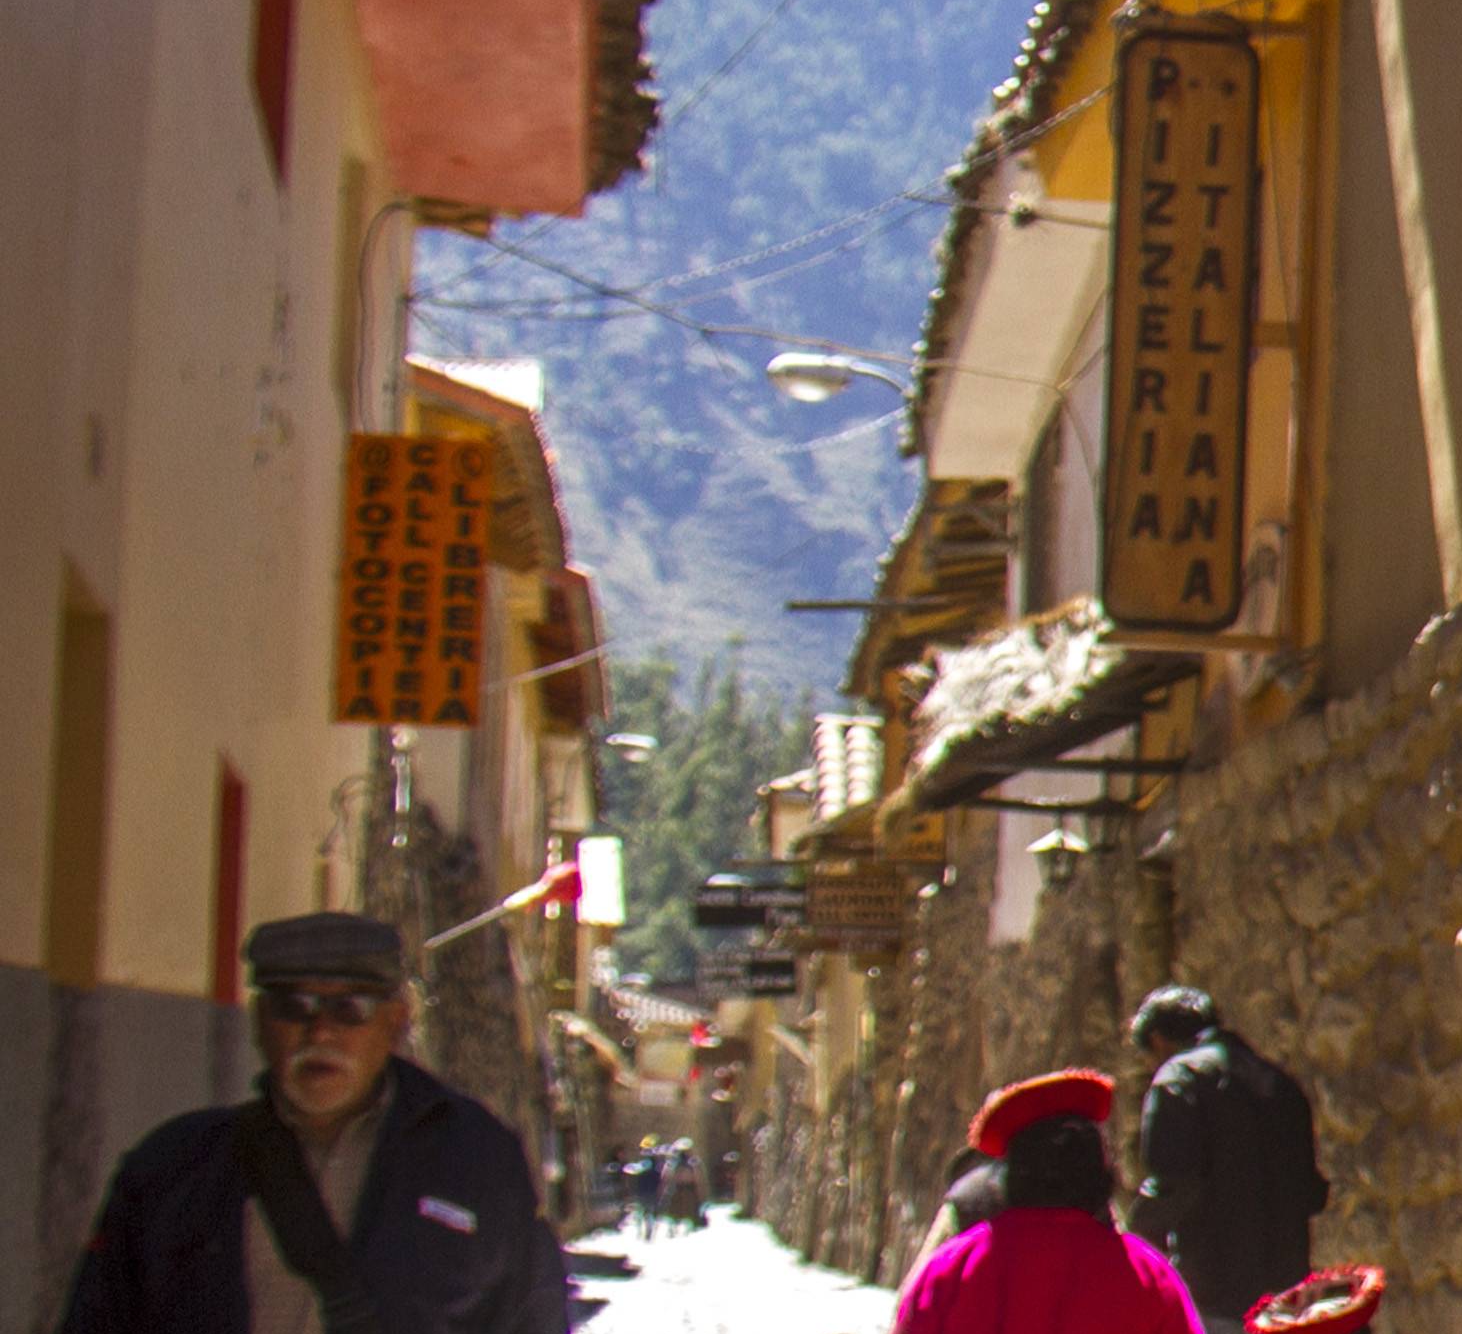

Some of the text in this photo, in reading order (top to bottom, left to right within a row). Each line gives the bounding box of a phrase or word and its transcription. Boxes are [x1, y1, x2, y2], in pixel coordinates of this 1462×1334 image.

[1129, 58, 1179, 539] PIZZERIA
[1177, 122, 1229, 606] ITALIANA
[347, 476, 392, 717] FOTOCOPIA
[394, 444, 435, 717] CALL CENTER
[436, 483, 481, 720] LIBRERIA
